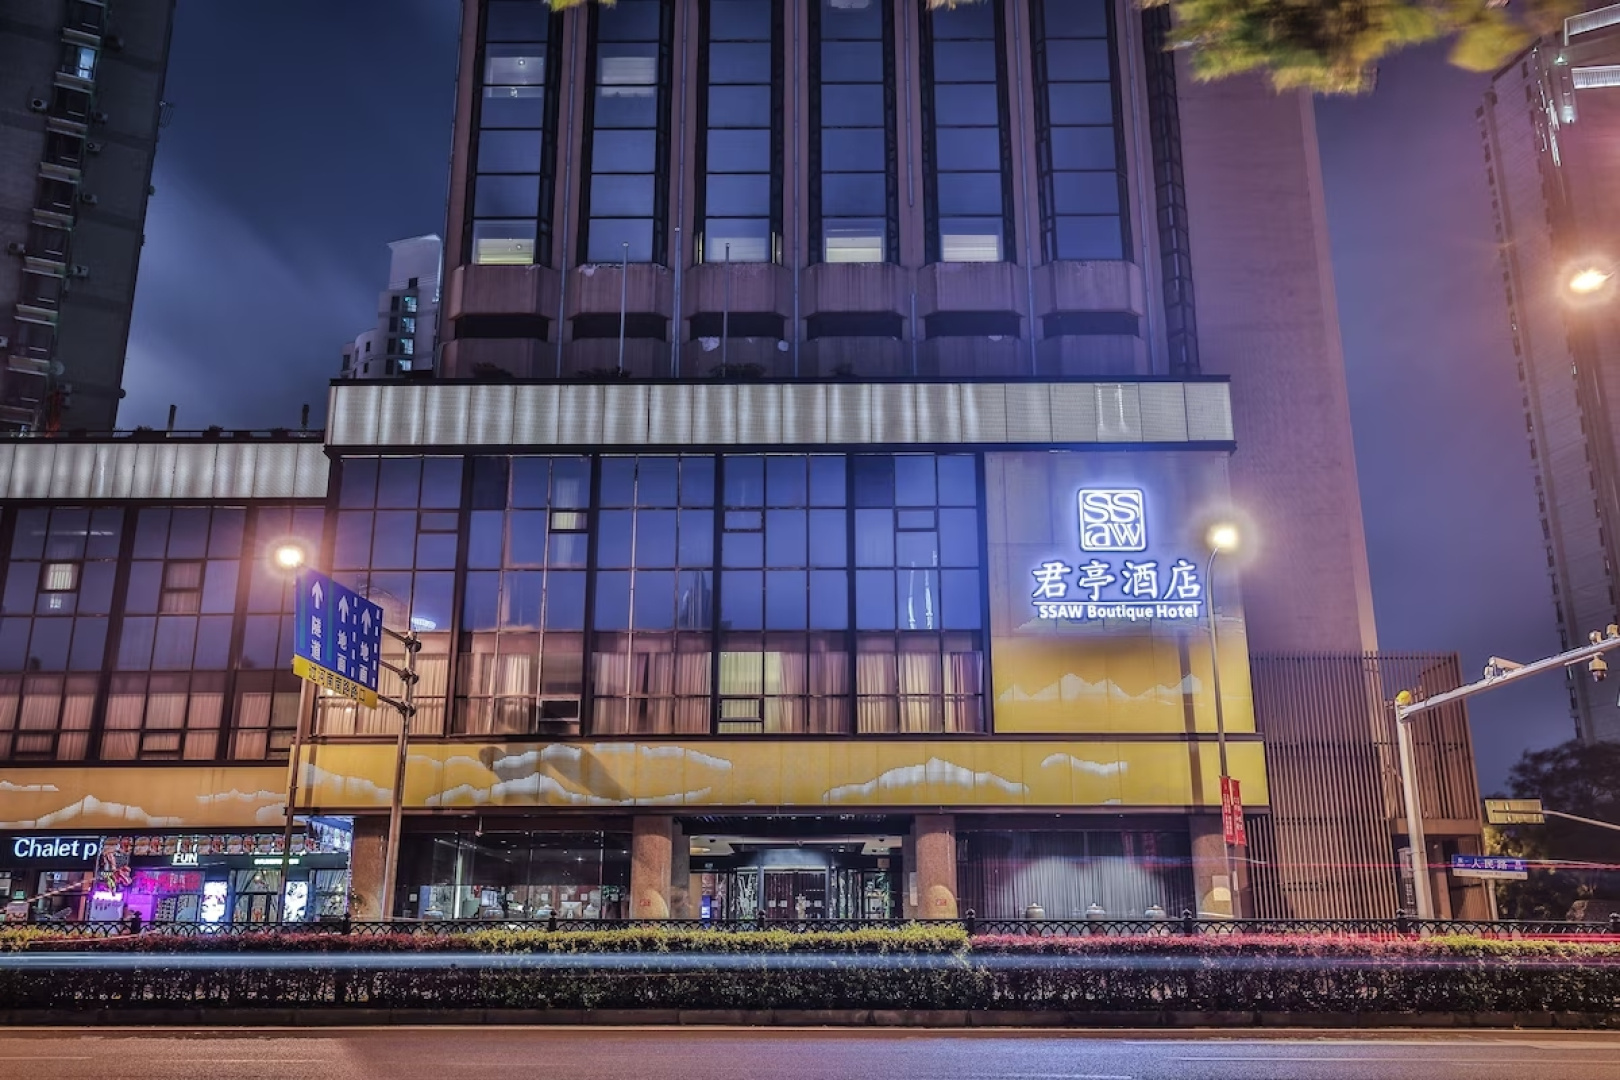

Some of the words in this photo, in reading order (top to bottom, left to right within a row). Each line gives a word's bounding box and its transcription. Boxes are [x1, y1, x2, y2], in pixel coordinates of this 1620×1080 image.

[1032, 559, 1201, 601] 君亭酒店
[1039, 605, 1083, 619] SSAW
[1087, 605, 1154, 621] Boutique
[1156, 605, 1198, 618] Hotel
[337, 630, 347, 673] 地面
[360, 642, 369, 683] 地面
[14, 838, 80, 857] Chalet
[173, 852, 198, 864] FUN
[1471, 857, 1508, 870] 人民路
